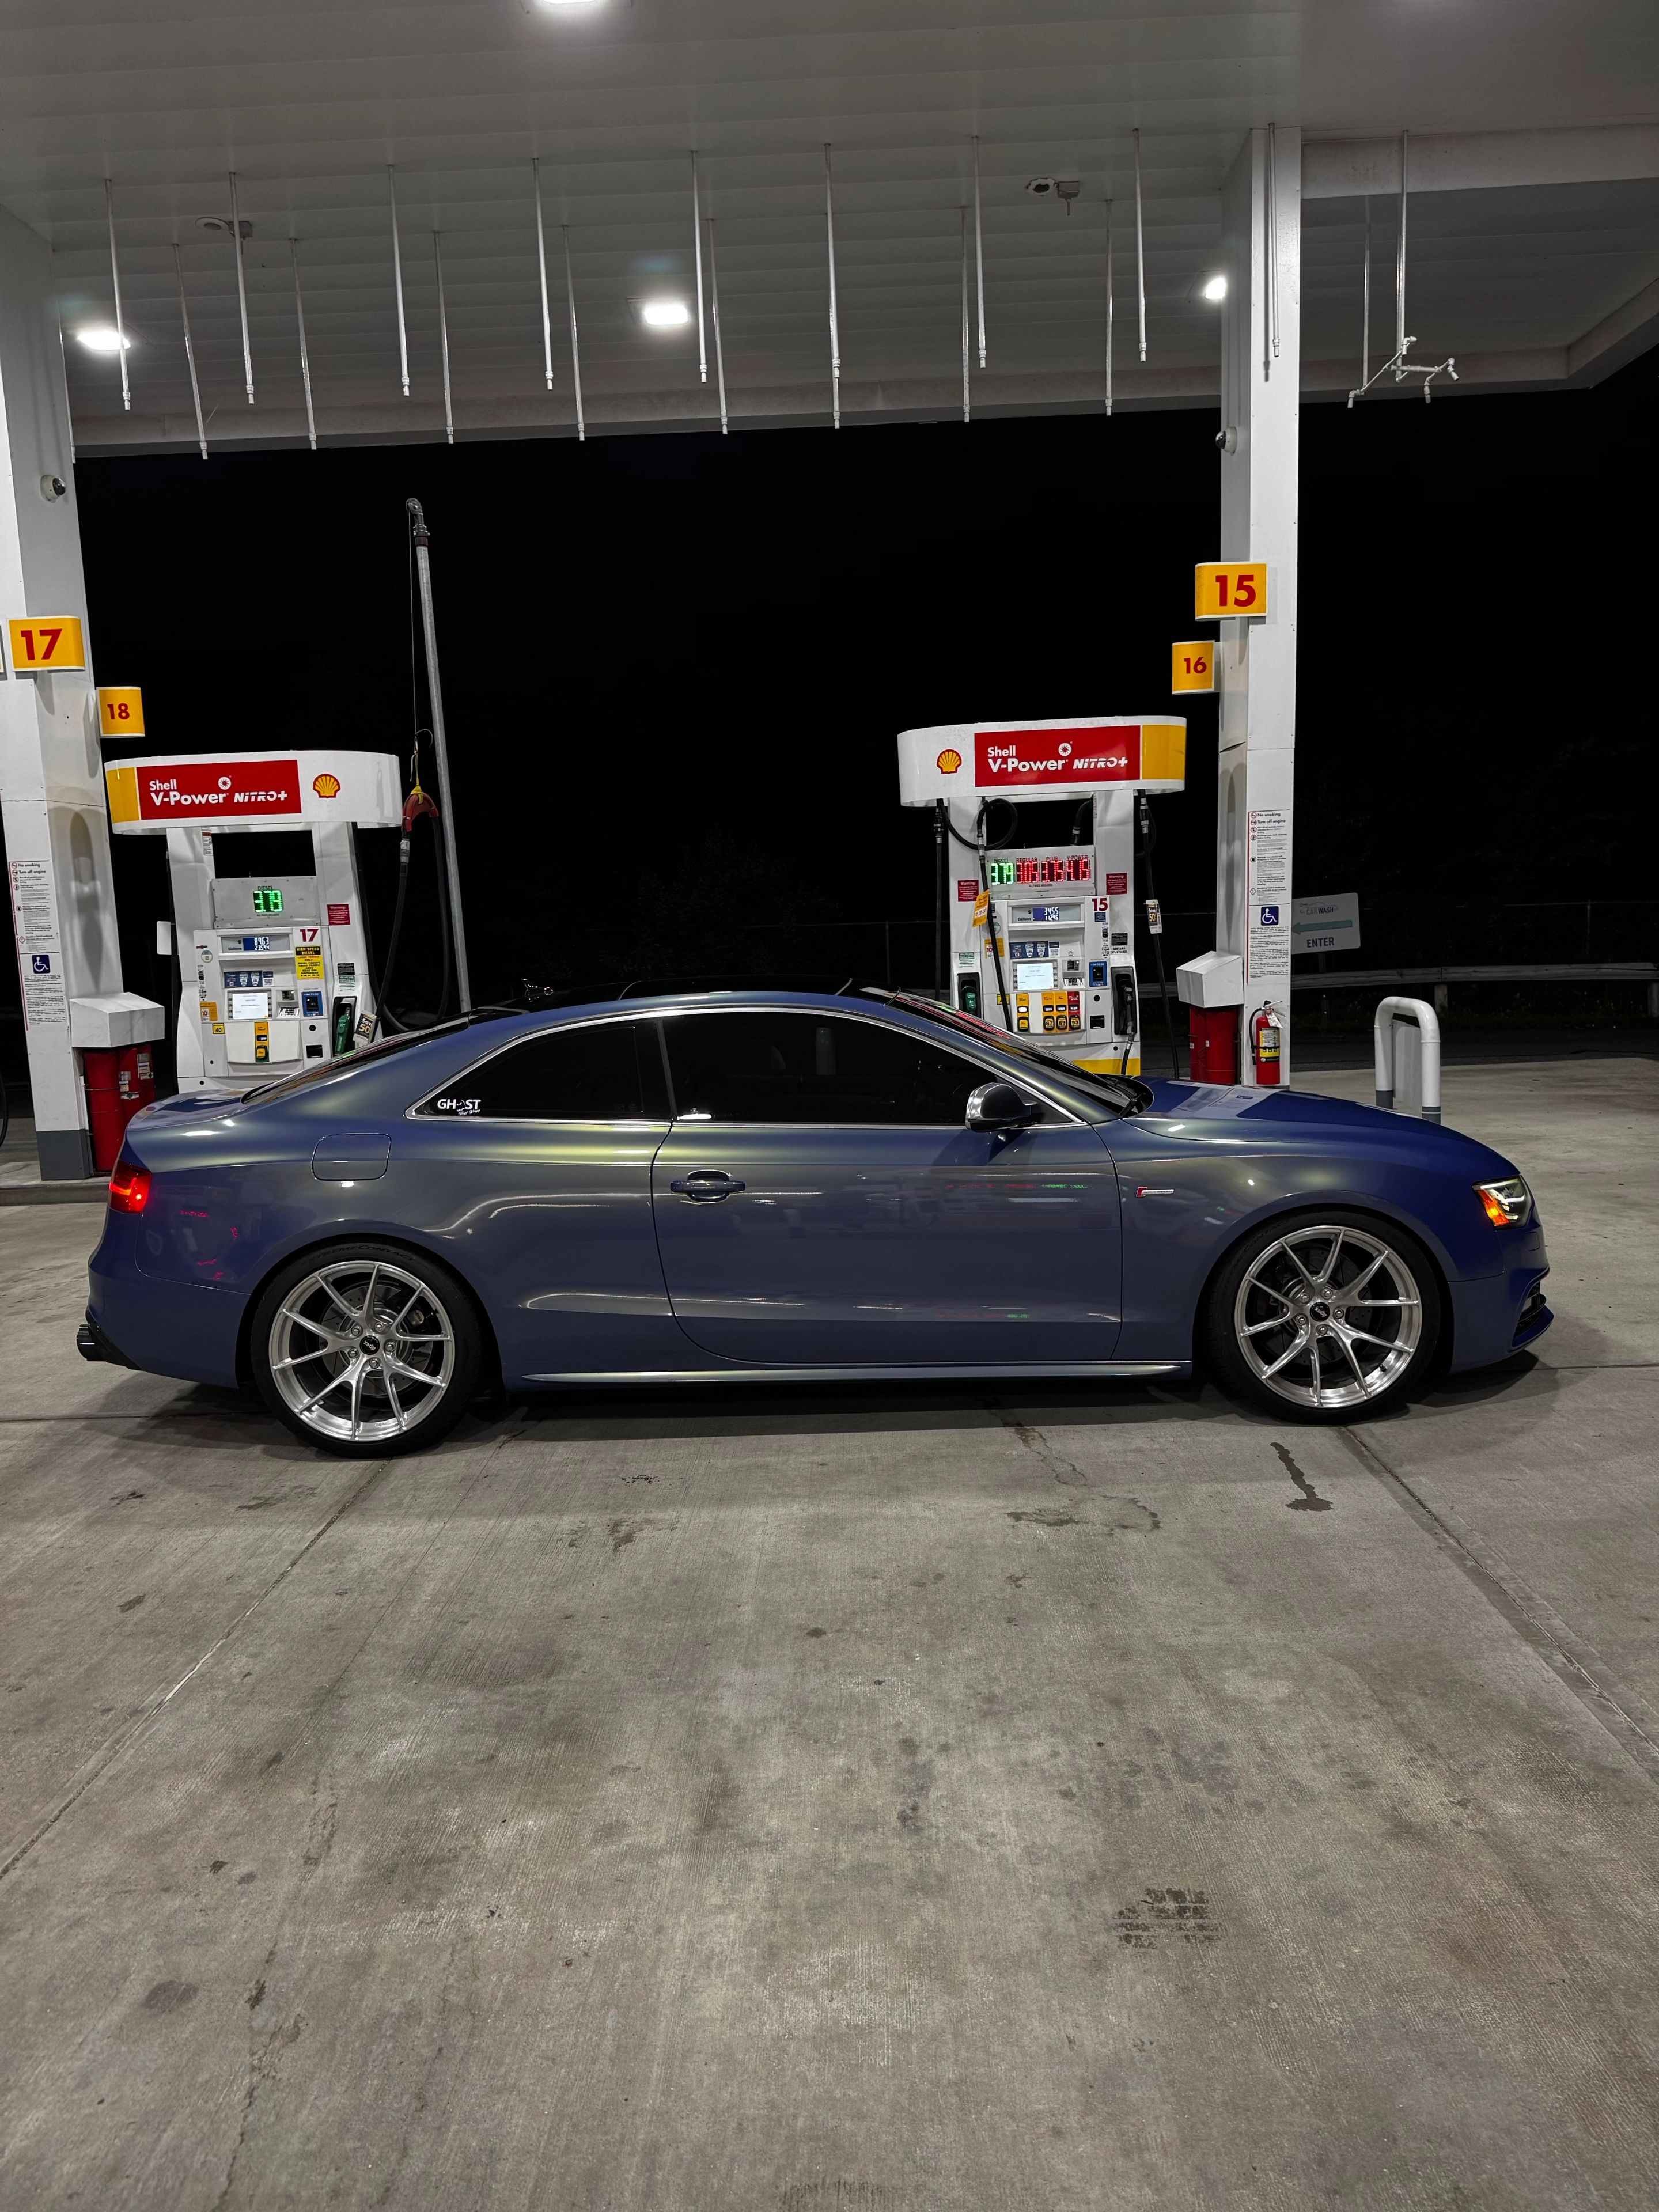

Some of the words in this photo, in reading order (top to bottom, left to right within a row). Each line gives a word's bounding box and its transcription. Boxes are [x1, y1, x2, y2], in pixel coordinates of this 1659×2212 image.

[1215, 574, 1256, 607] 15
[20, 628, 62, 661] 17
[1184, 657, 1207, 674] 16
[107, 703, 130, 720] 18
[987, 745, 1016, 757] Shell
[988, 757, 1066, 772] V-Power
[149, 779, 177, 791] Shell
[150, 791, 226, 806] V-Power
[1092, 897, 1108, 911] 15
[300, 928, 319, 942] 17
[1306, 937, 1334, 948] ENTER
